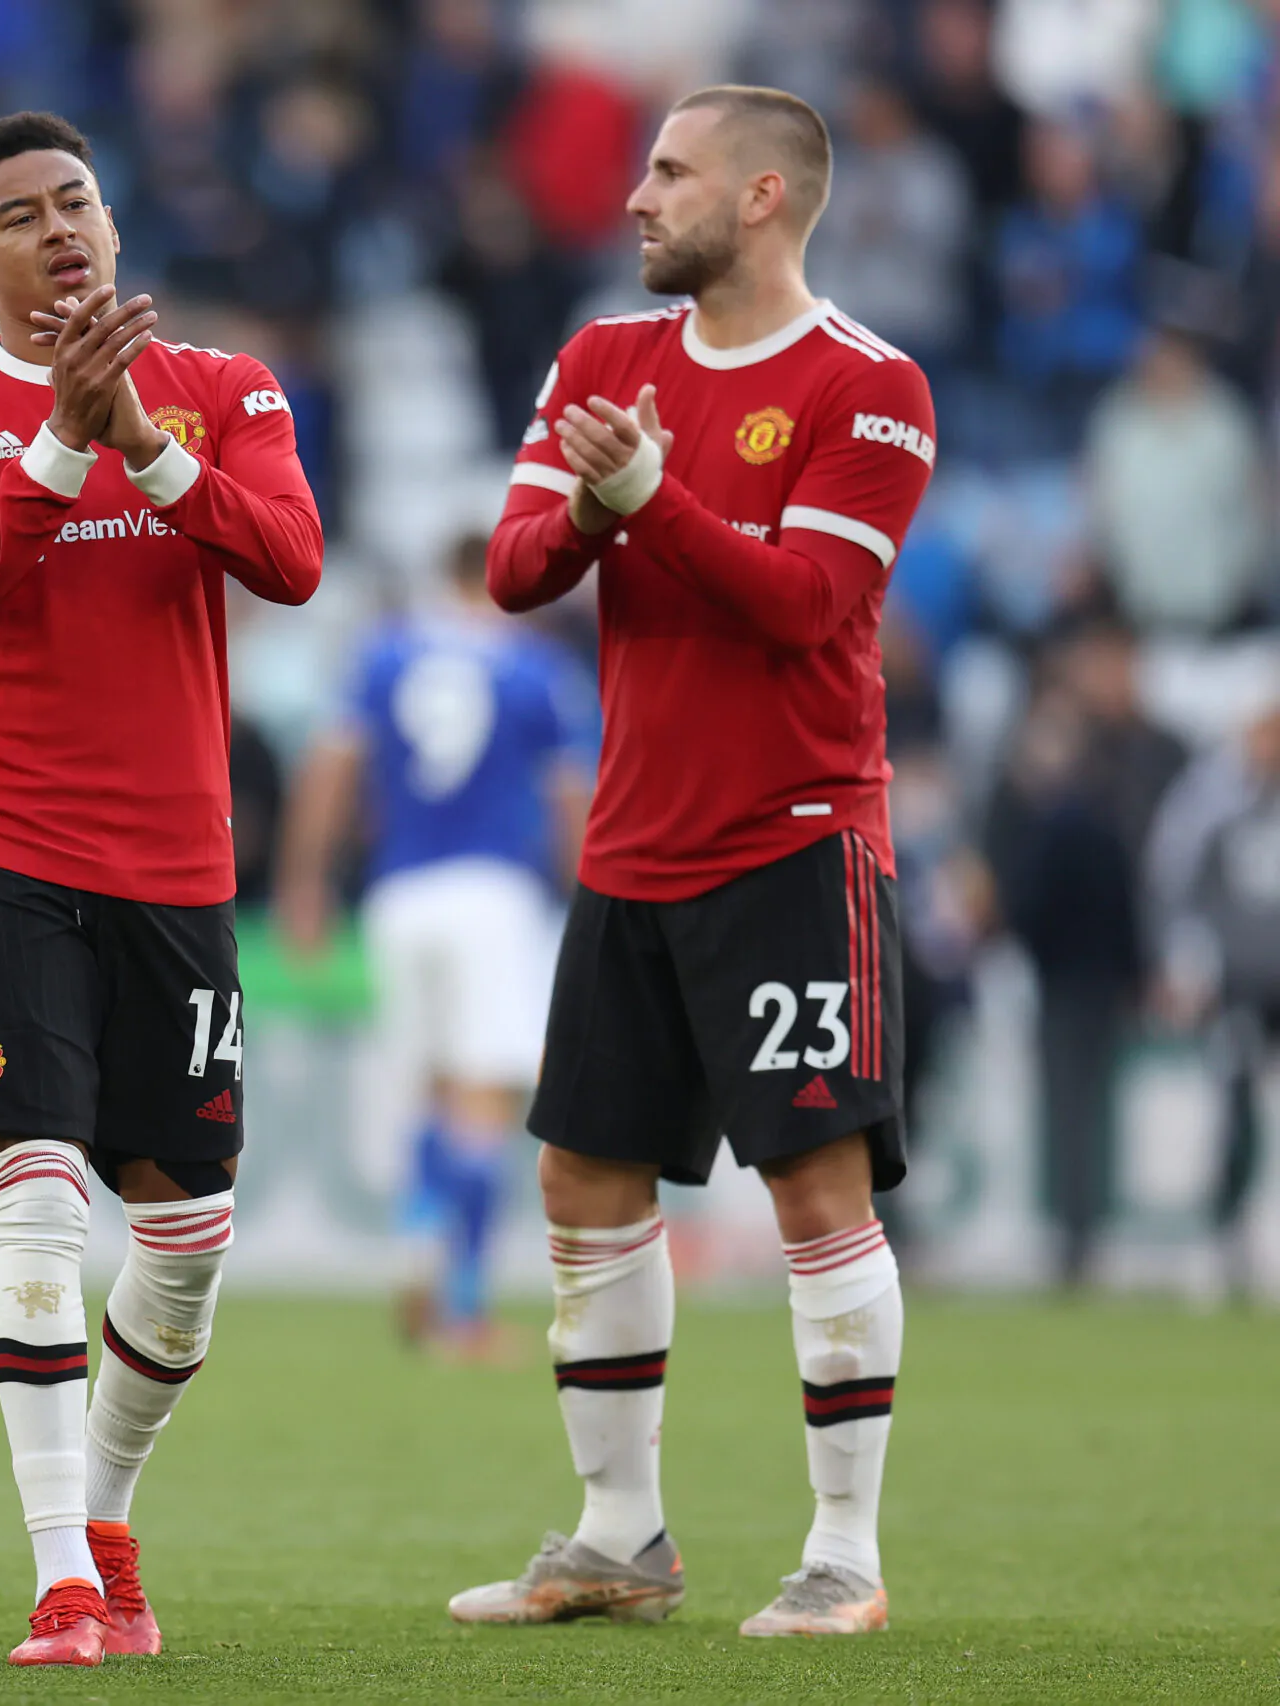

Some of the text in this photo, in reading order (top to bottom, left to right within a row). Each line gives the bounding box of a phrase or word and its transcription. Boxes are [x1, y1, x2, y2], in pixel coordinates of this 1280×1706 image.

[149, 409, 197, 424] ANCHESTER
[53, 508, 178, 543] eamVie
[187, 988, 243, 1081] 14
[749, 980, 851, 1072] 23
[196, 1107, 237, 1124] adidas
